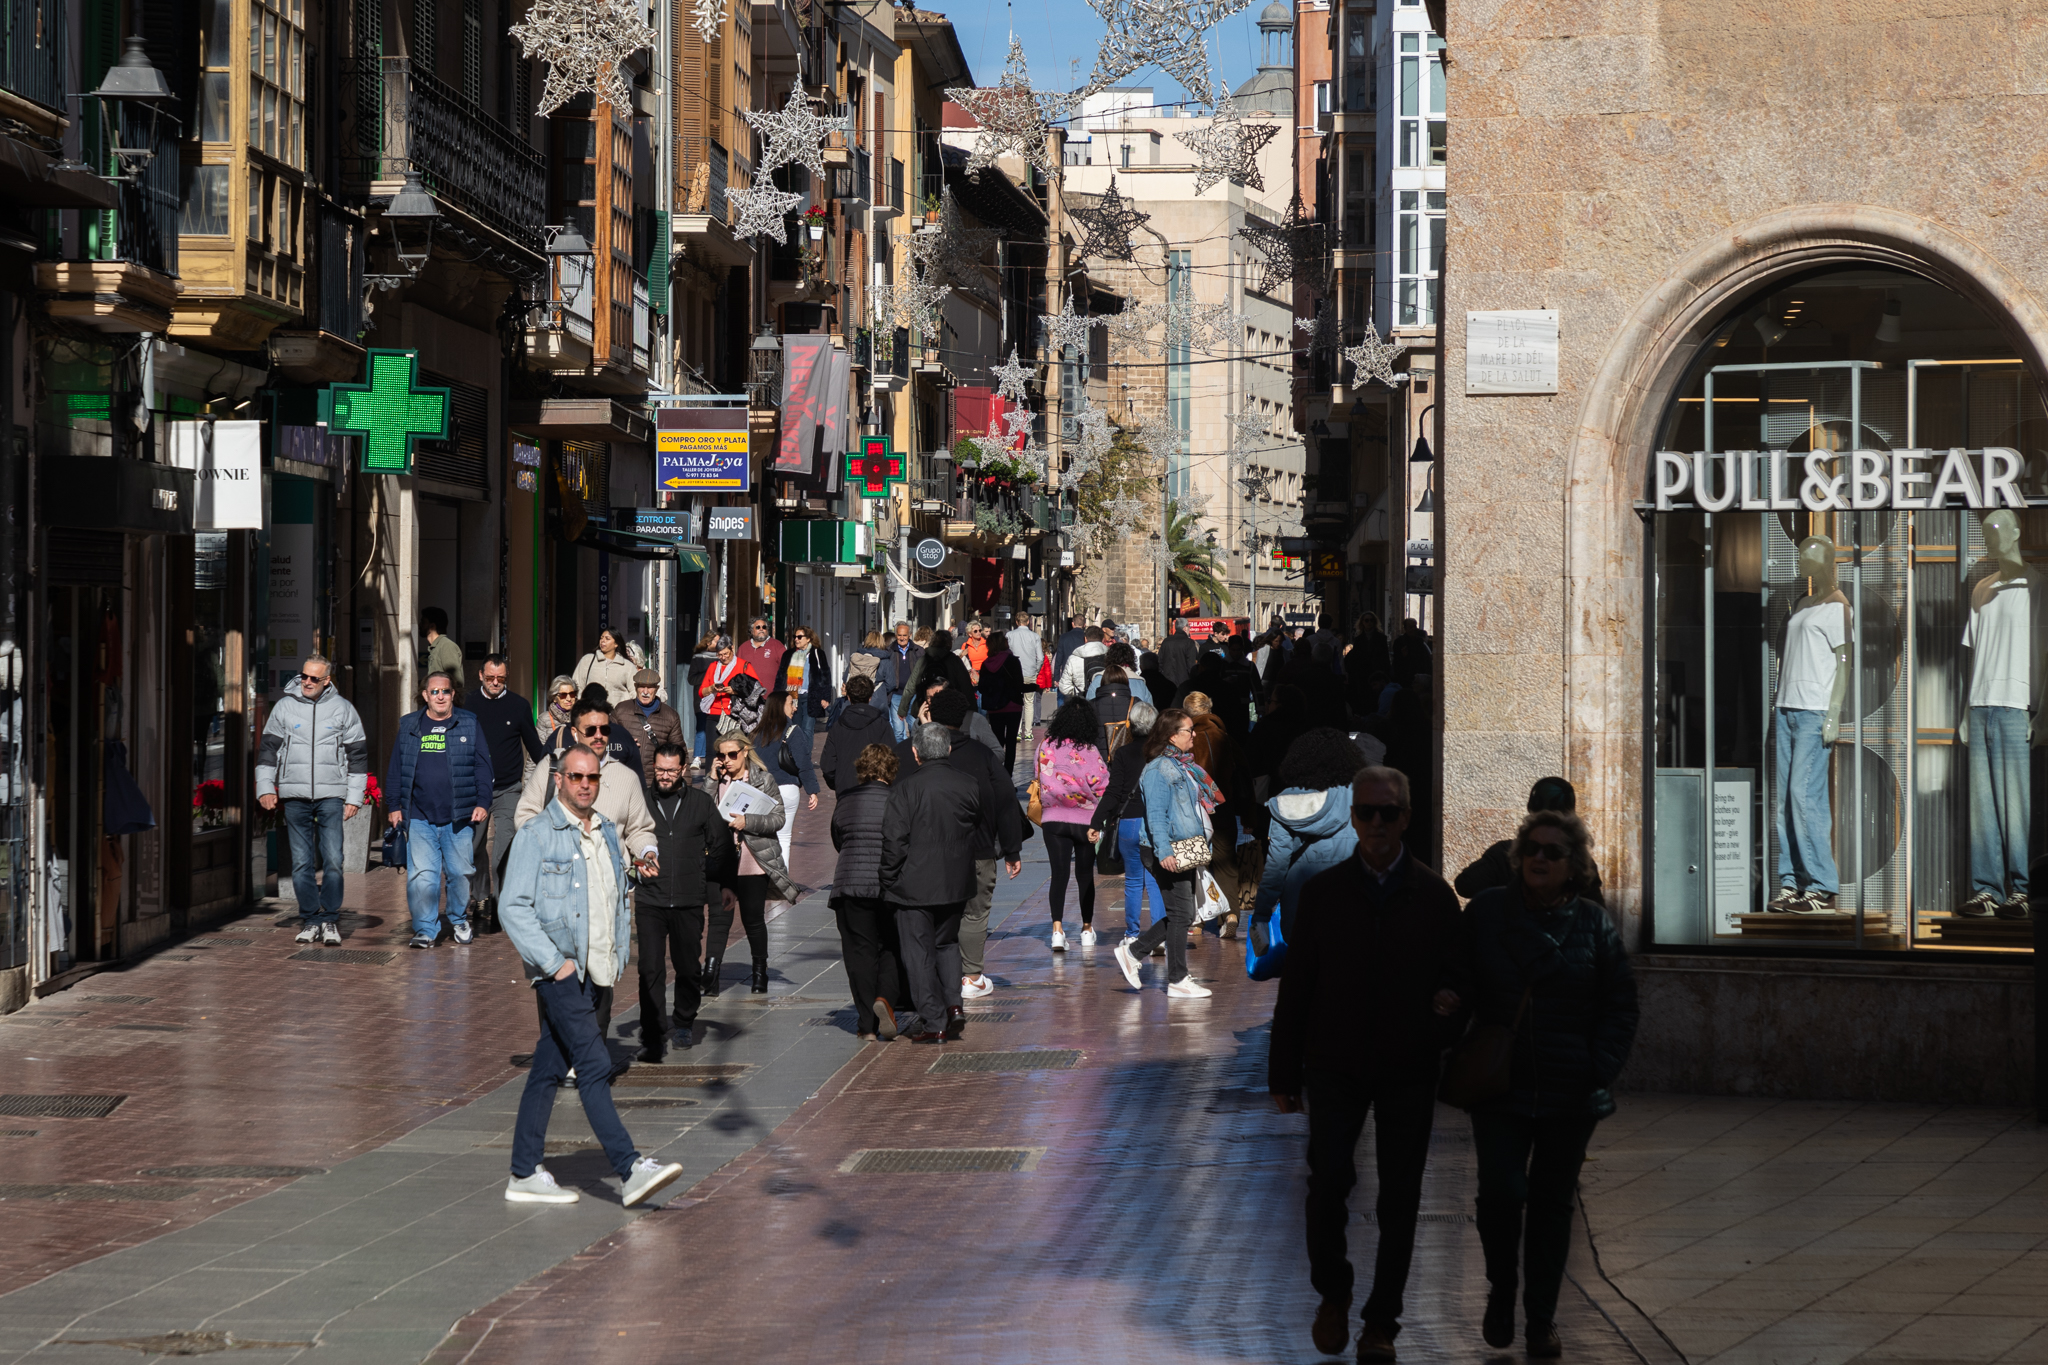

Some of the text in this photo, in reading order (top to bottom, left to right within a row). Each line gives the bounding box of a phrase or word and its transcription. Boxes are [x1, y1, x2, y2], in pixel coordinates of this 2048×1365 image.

[1497, 318, 1527, 331] PLAÇA
[1498, 336, 1526, 348] DE LA
[1480, 354, 1507, 365] MARE
[1511, 353, 1522, 364] DE
[1481, 370, 1542, 382] DE LA SALUT
[1655, 447, 2029, 513] PULL&BEAR
[634, 516, 664, 524] CENTRO
[709, 516, 744, 532] snipes
[626, 526, 683, 534] REPARACIONES
[280, 580, 295, 588] por
[1715, 794, 1727, 804] Bring
[1721, 818, 1735, 827] longer
[1729, 828, 1738, 838] give
[1727, 852, 1732, 860] of
